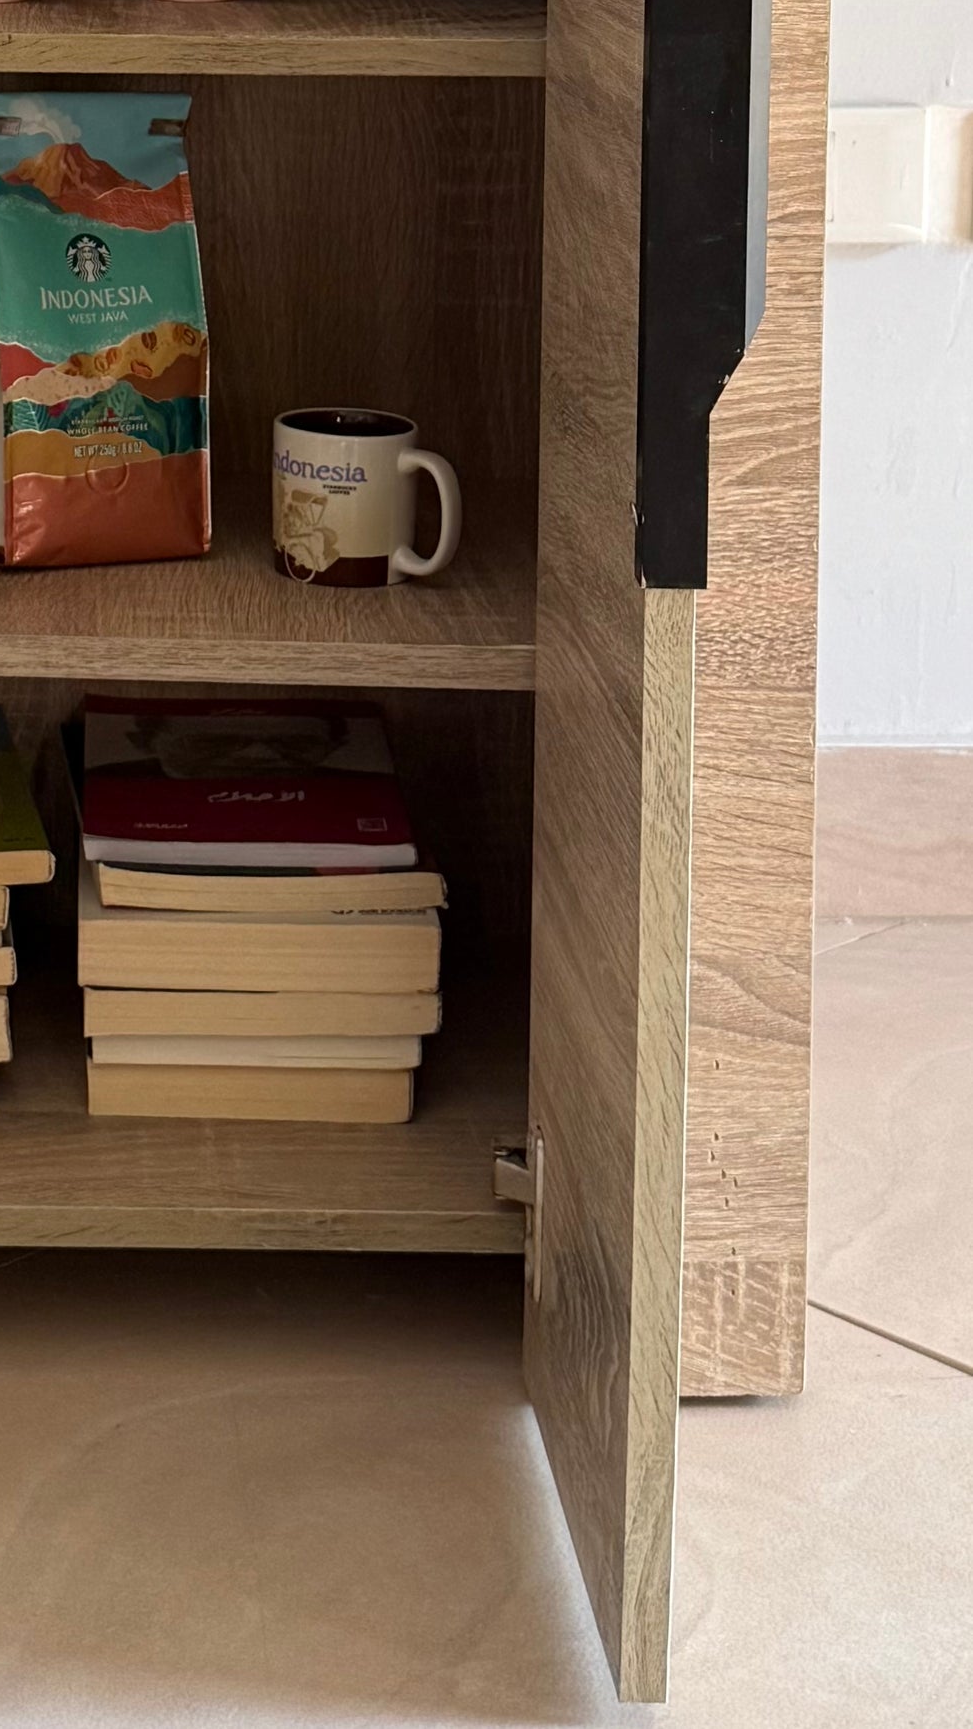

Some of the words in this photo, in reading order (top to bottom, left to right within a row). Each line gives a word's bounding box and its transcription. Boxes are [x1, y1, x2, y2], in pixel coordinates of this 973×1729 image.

[39, 285, 153, 311] INDONESIA
[67, 312, 98, 325] WEST
[100, 310, 129, 323] JAVA
[67, 427, 96, 436] WHOLE
[98, 425, 120, 434] BEAN
[120, 422, 149, 432] COFFEE
[73, 445, 87, 458] NET
[87, 444, 98, 457] WT
[99, 443, 117, 457] 250g
[133, 441, 143, 453] OZ
[273, 449, 368, 483] ndonesia
